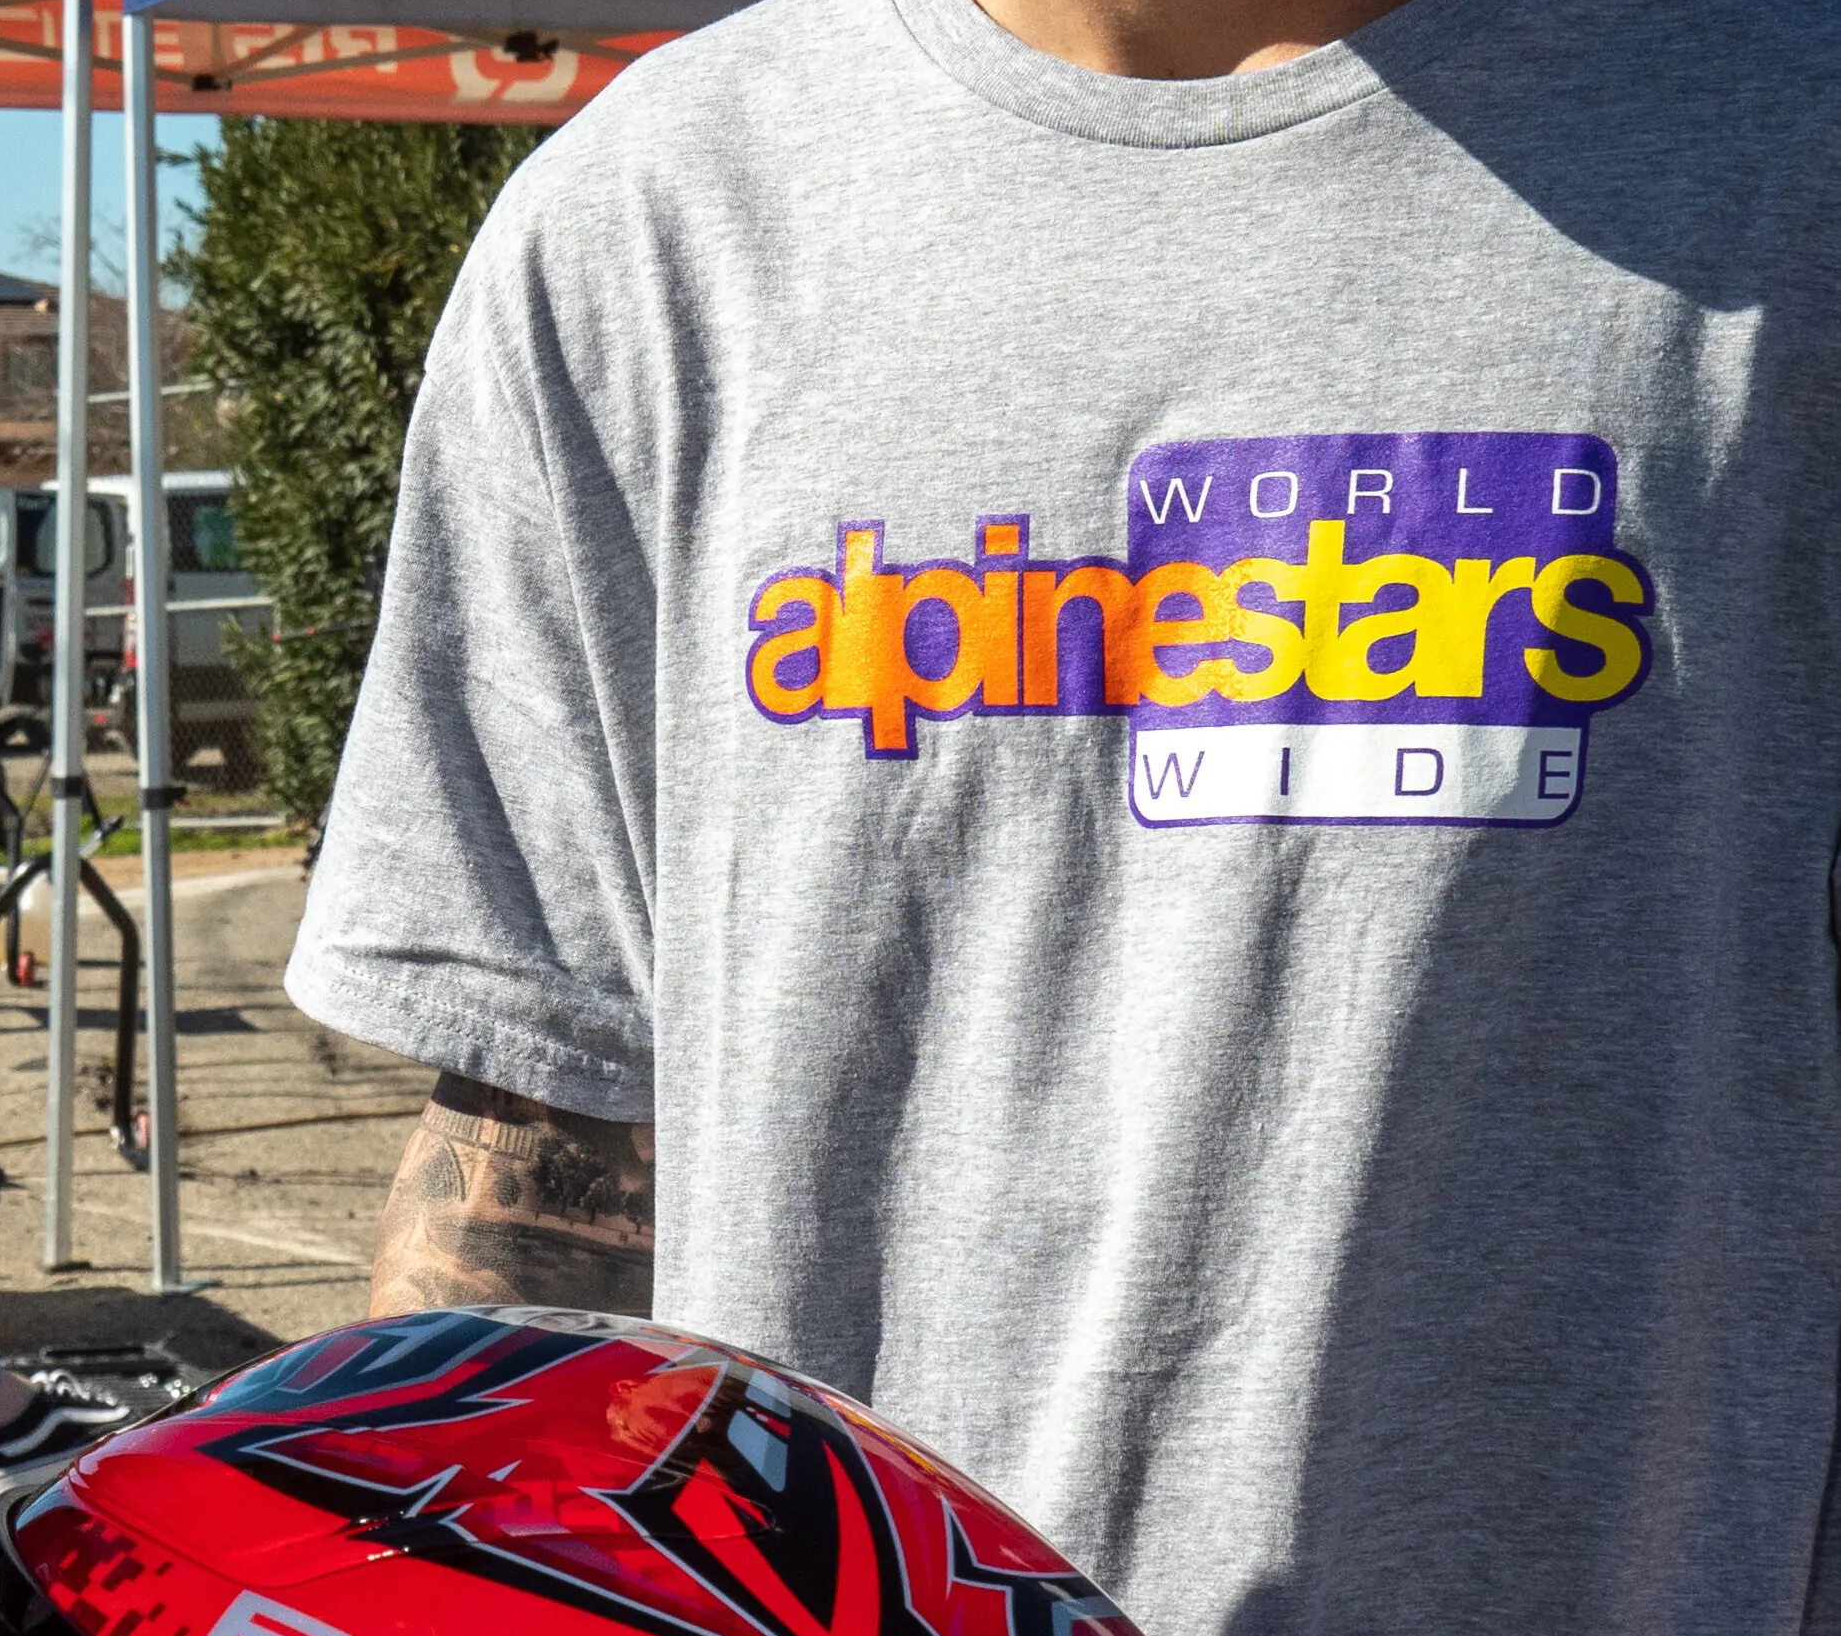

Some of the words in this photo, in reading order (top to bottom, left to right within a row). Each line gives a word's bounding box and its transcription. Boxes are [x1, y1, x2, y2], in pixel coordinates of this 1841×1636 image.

[1138, 467, 1603, 525] WORLD
[747, 515, 1656, 761] alpinestars
[1142, 745, 1576, 801] WIDE
